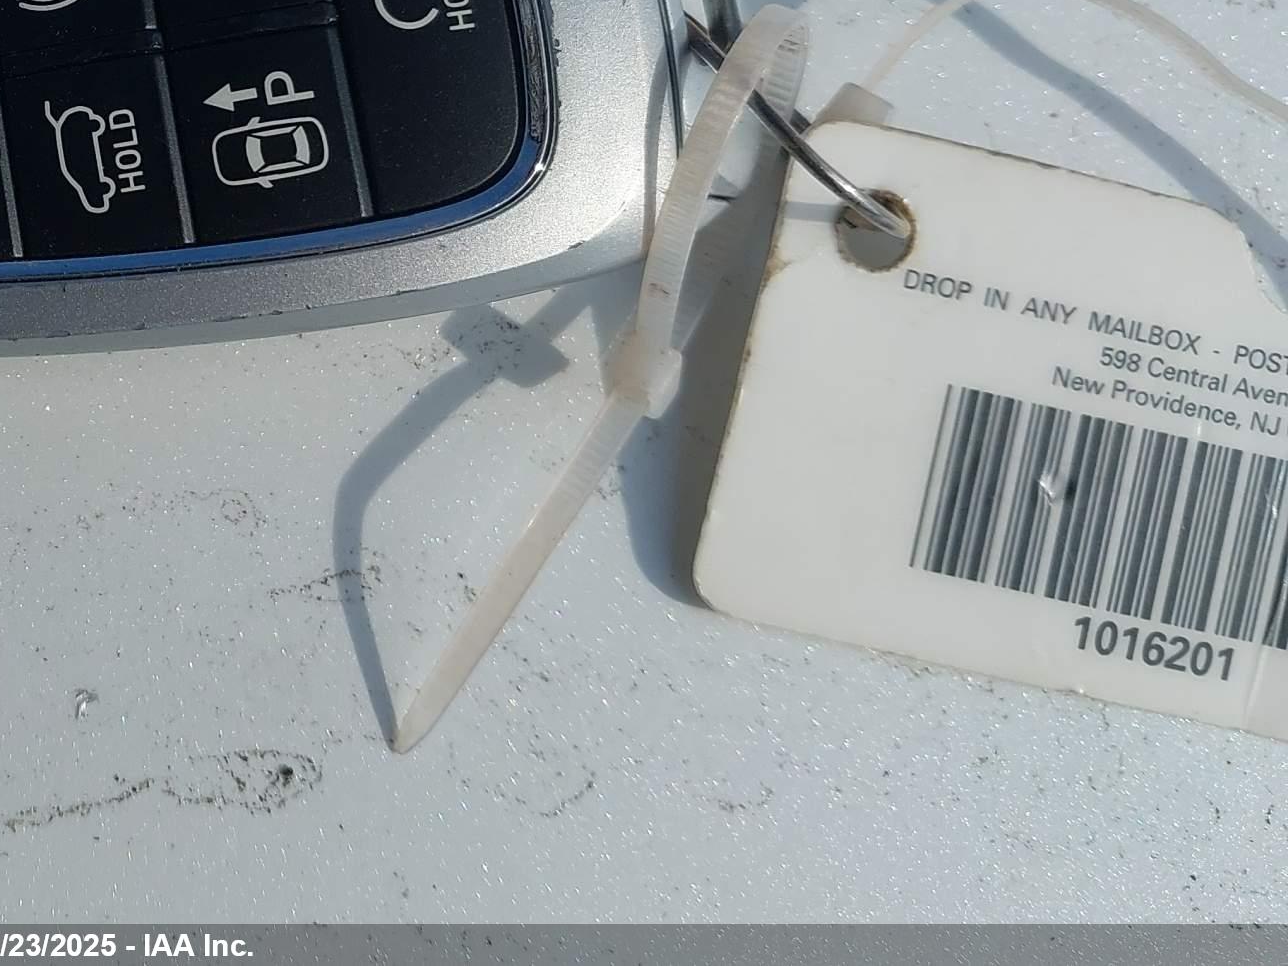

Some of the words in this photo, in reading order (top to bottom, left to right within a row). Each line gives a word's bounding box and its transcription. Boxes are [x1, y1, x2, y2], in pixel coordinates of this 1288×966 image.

[265, 72, 314, 105] P
[109, 110, 145, 192] HOLD
[905, 270, 971, 299] DROP
[985, 288, 1008, 310] IN
[1021, 298, 1076, 323] ANY
[1089, 312, 1200, 354] MAILBOX
[1053, 367, 1104, 394] New
[1112, 380, 1240, 429] Providence,
[1251, 412, 1281, 435] NJ
[1101, 347, 1141, 372] 598
[1148, 358, 1227, 392] Central
[1076, 617, 1233, 680] 1016201
